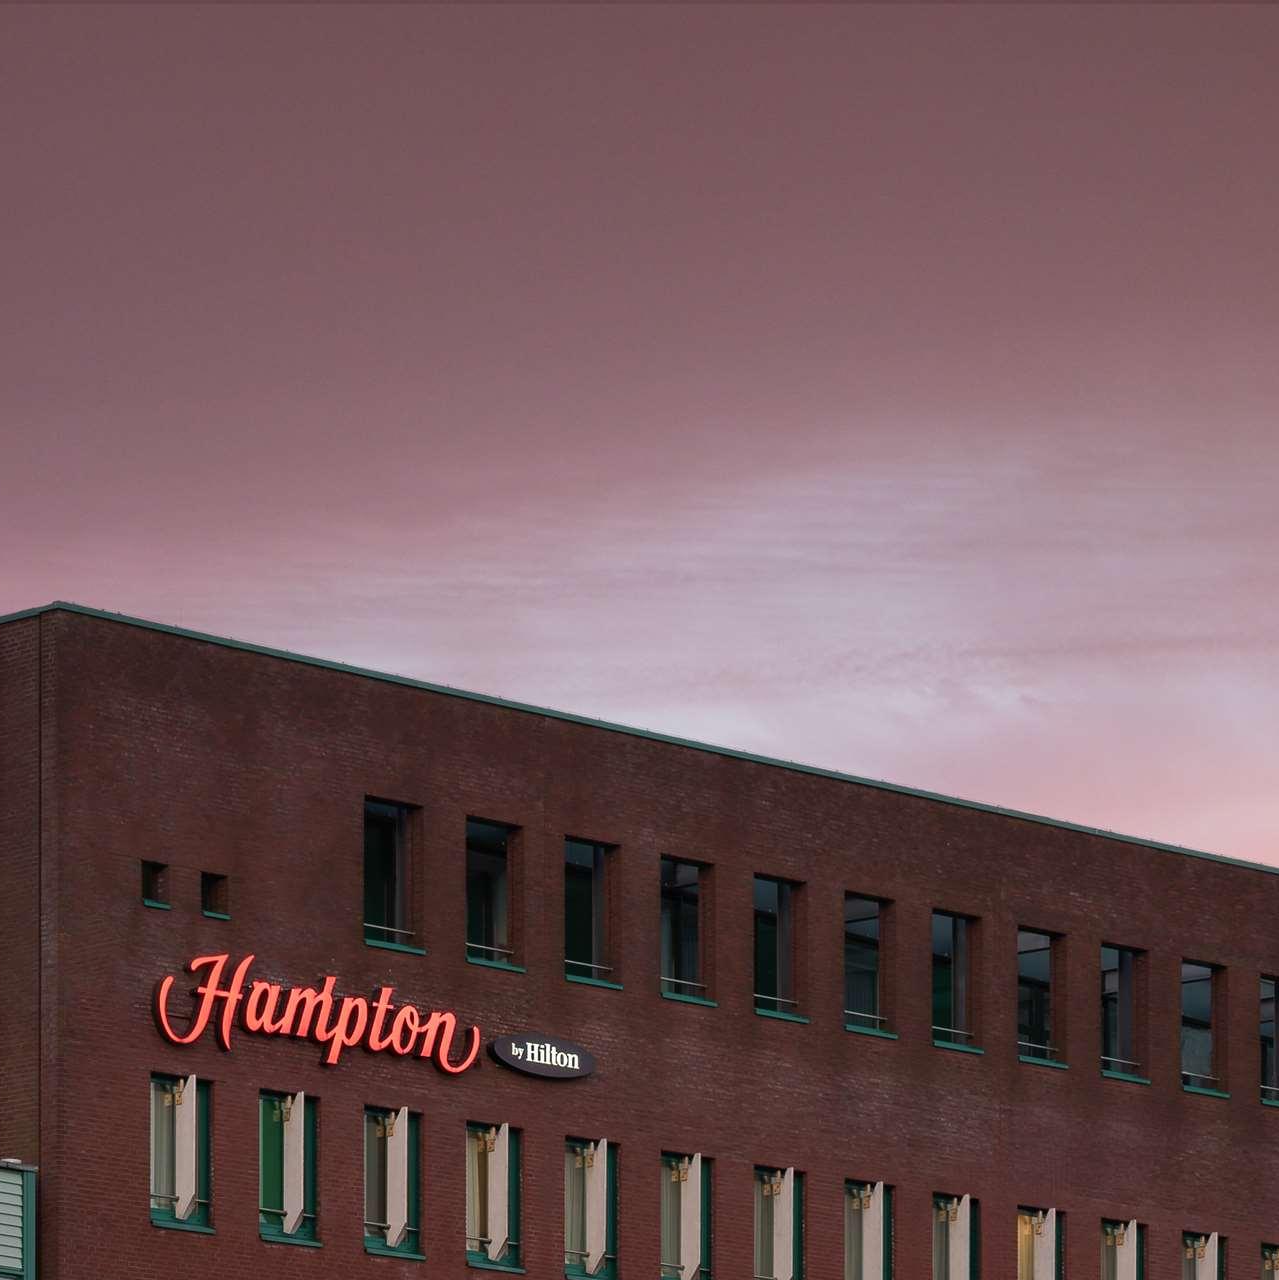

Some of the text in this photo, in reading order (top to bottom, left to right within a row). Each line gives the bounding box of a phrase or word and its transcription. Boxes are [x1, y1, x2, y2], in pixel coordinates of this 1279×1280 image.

[157, 953, 481, 1075] Hampton
[511, 1041, 581, 1071] by Hilton
